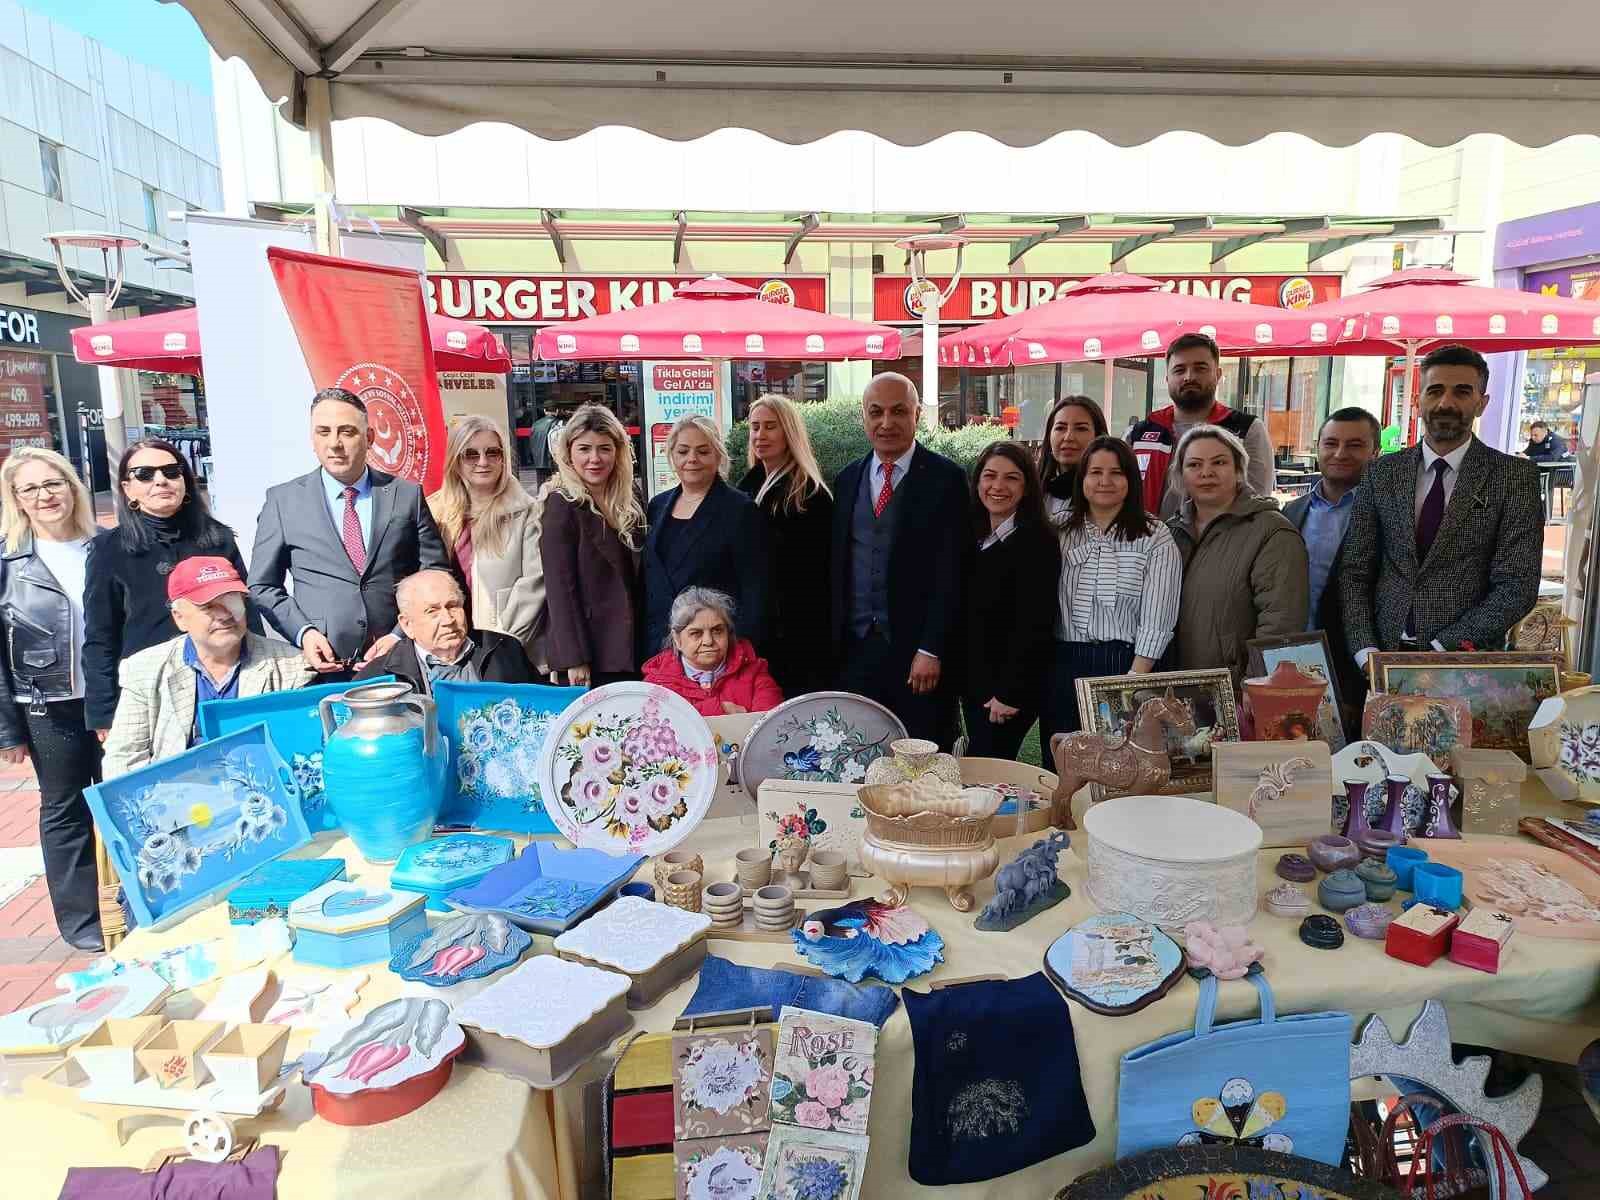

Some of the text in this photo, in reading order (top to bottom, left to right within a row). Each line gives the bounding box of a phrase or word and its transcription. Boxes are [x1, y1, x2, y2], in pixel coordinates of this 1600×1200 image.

[609, 280, 691, 313] KIN
[971, 279, 1085, 317] BUR
[1286, 291, 1311, 307] KING
[0, 307, 40, 345] FOR
[439, 378, 496, 390] HVELER
[663, 380, 681, 390] Gel
[657, 392, 714, 405] indiriml
